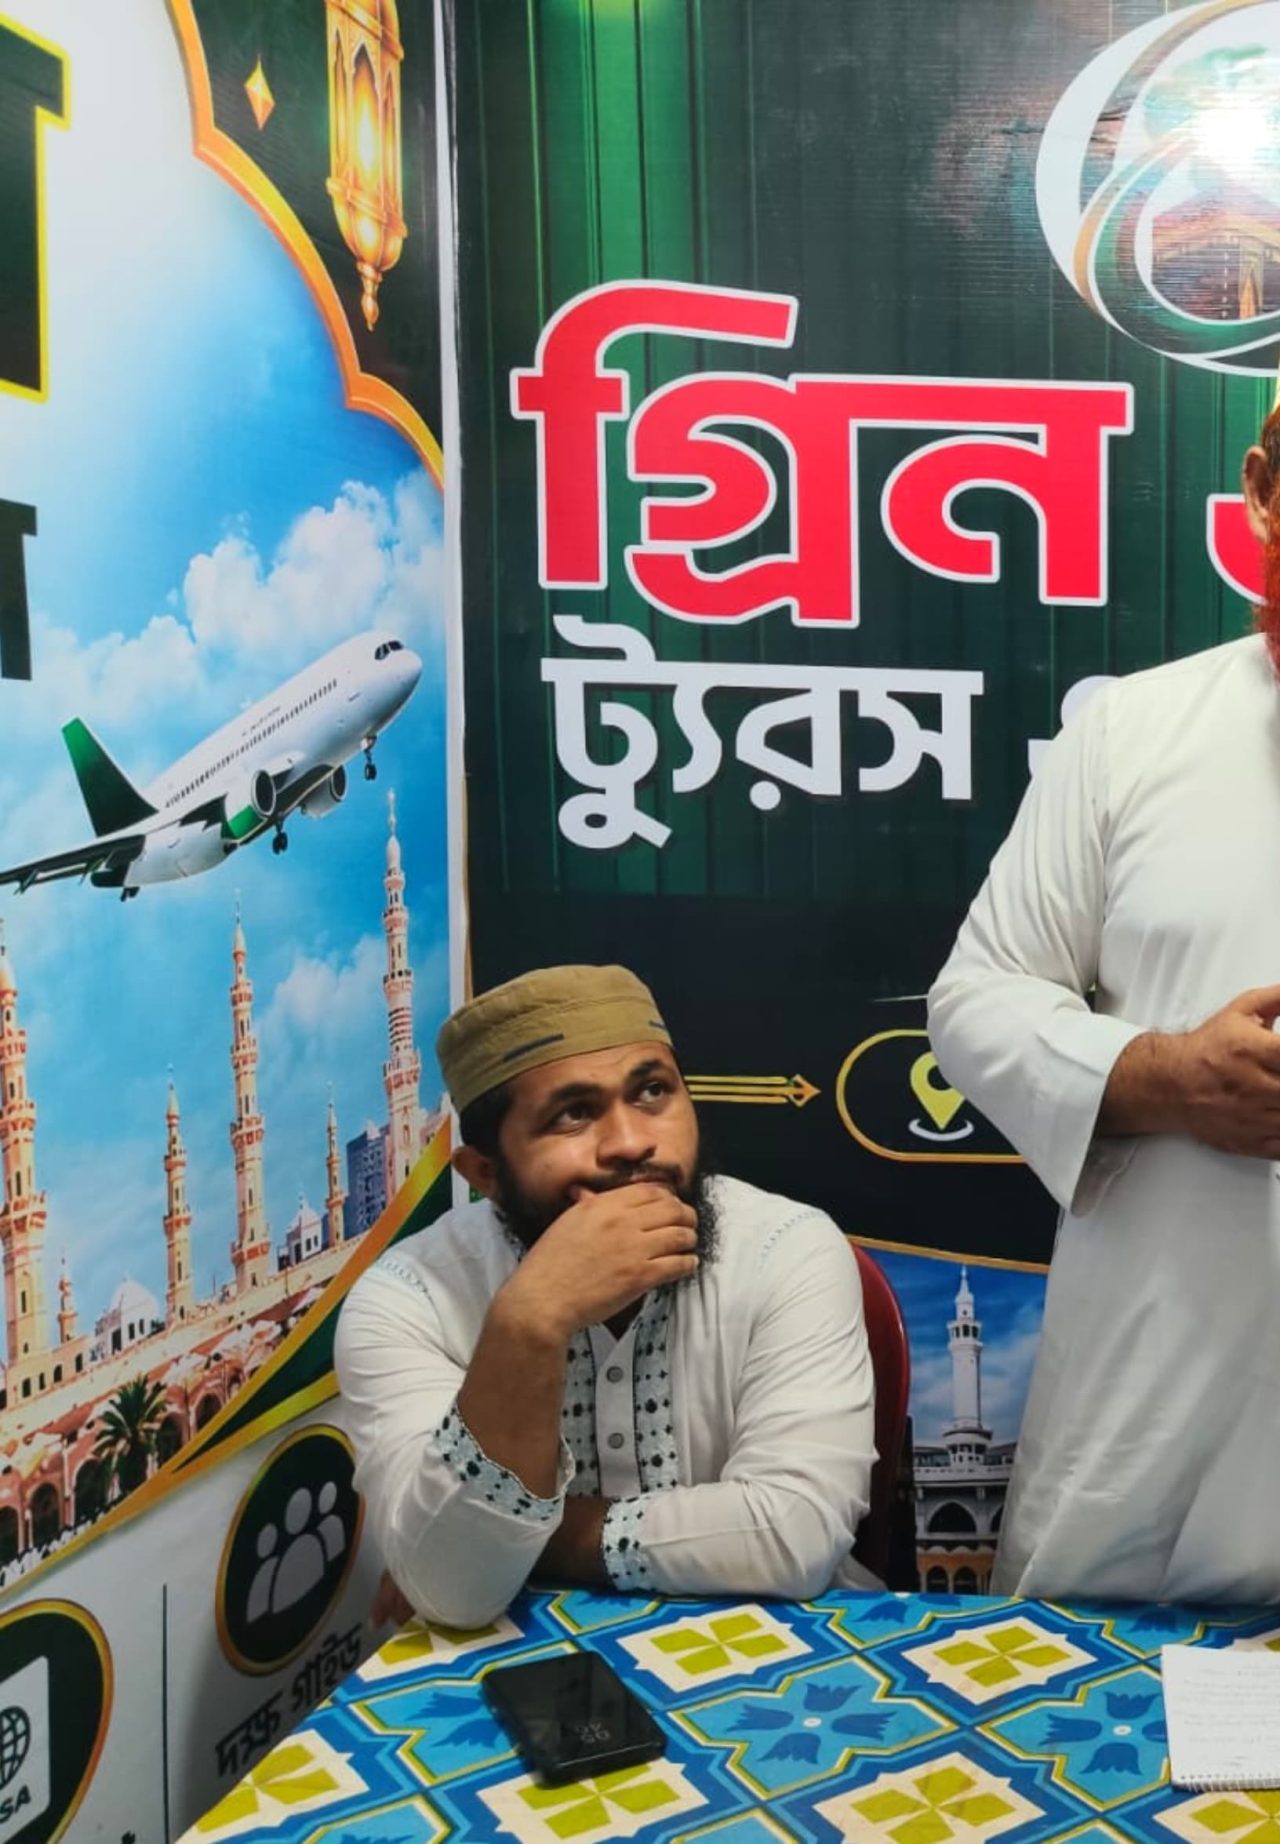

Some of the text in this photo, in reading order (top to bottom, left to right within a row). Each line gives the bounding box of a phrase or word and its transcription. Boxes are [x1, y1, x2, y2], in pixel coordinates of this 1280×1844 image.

[511, 279, 1134, 629] গ্রিন
[541, 614, 984, 850] ট্যুরস
[0, 1783, 32, 1824] SA
